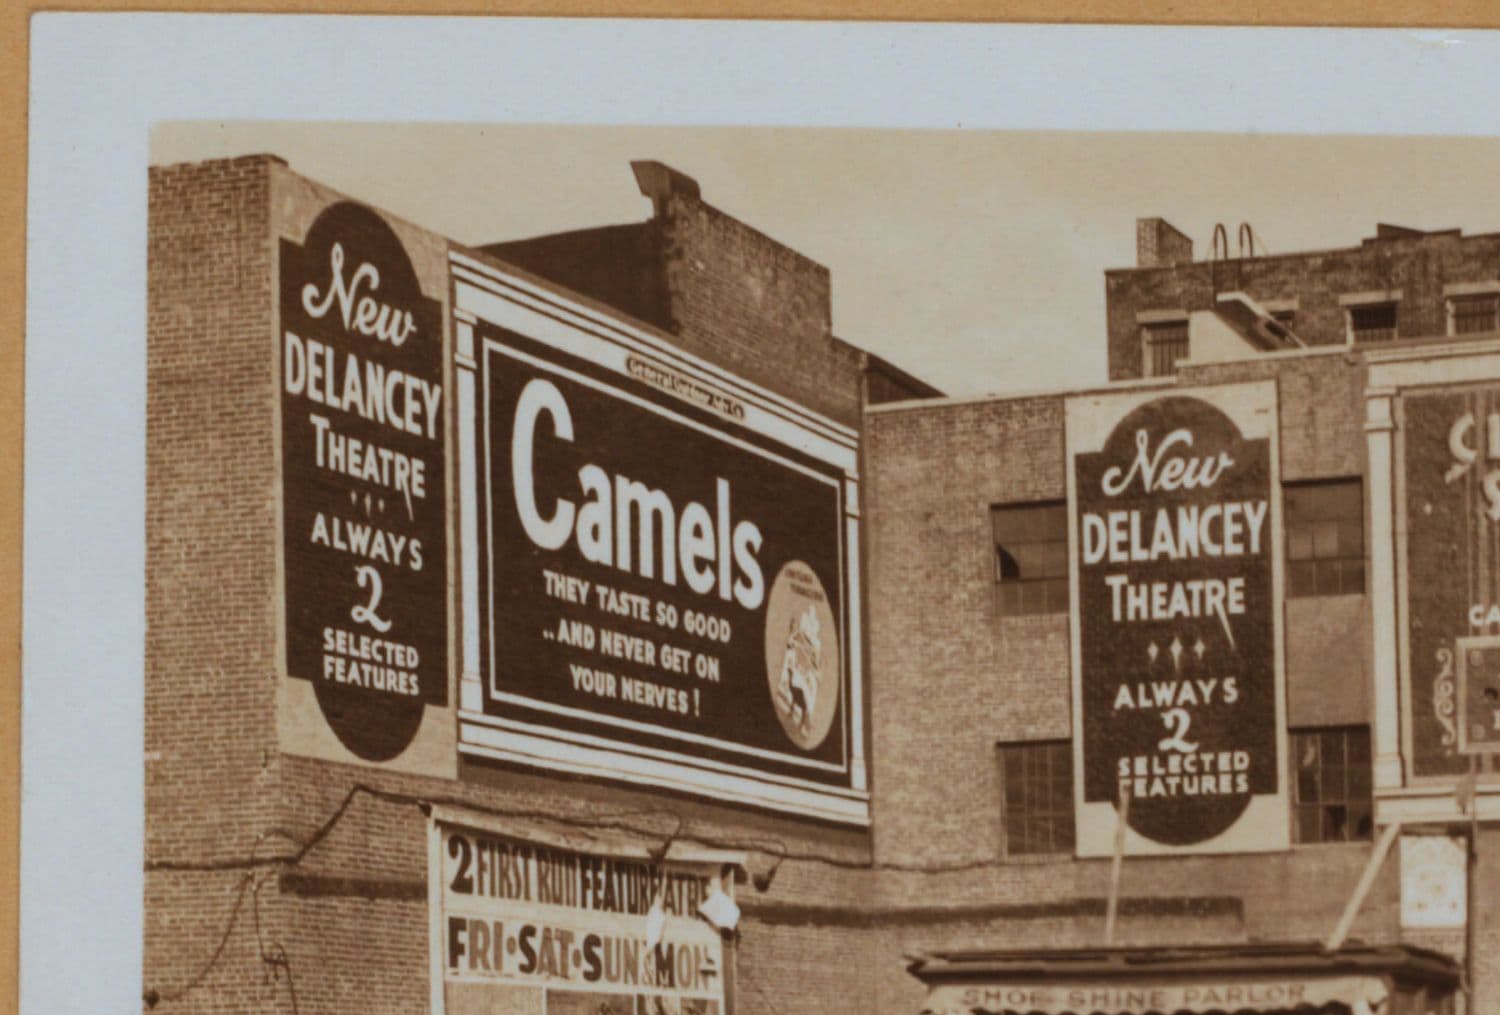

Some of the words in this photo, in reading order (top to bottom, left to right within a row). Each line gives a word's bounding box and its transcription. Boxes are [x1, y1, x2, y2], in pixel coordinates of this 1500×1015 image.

[302, 243, 416, 346] New
[285, 331, 442, 440] DELANCEY
[310, 414, 426, 520] THEATRE
[512, 378, 764, 610] Camels
[1102, 429, 1235, 496] New
[311, 513, 423, 571] ALWAYS
[1082, 501, 1268, 565] DELANCEY
[351, 566, 392, 632] 2
[543, 569, 590, 605] THEY
[596, 584, 651, 622] TASTE
[656, 601, 678, 629] SO
[684, 609, 731, 643] GOOD
[1105, 575, 1246, 648] THEATRE
[323, 627, 419, 668] SELECTED
[323, 655, 419, 696] FEATURES
[601, 628, 655, 666] NEVER
[660, 644, 691, 674] GET
[696, 653, 720, 682] ON
[569, 663, 616, 698] YOUR
[1113, 677, 1240, 710] ALWAYS
[1158, 708, 1200, 752] 2
[1118, 751, 1250, 777] SELECTED
[1118, 774, 1249, 798] FEATURES
[449, 834, 474, 894] 2
[476, 840, 533, 901] FIRST
[536, 850, 578, 908] RUN
[448, 916, 503, 971] FRI
[519, 924, 575, 981] SAT
[583, 933, 640, 985] SUN
[963, 987, 1043, 1005] SHOE
[1068, 988, 1167, 1009] SHINE
[1184, 983, 1306, 1004] PARLOR
